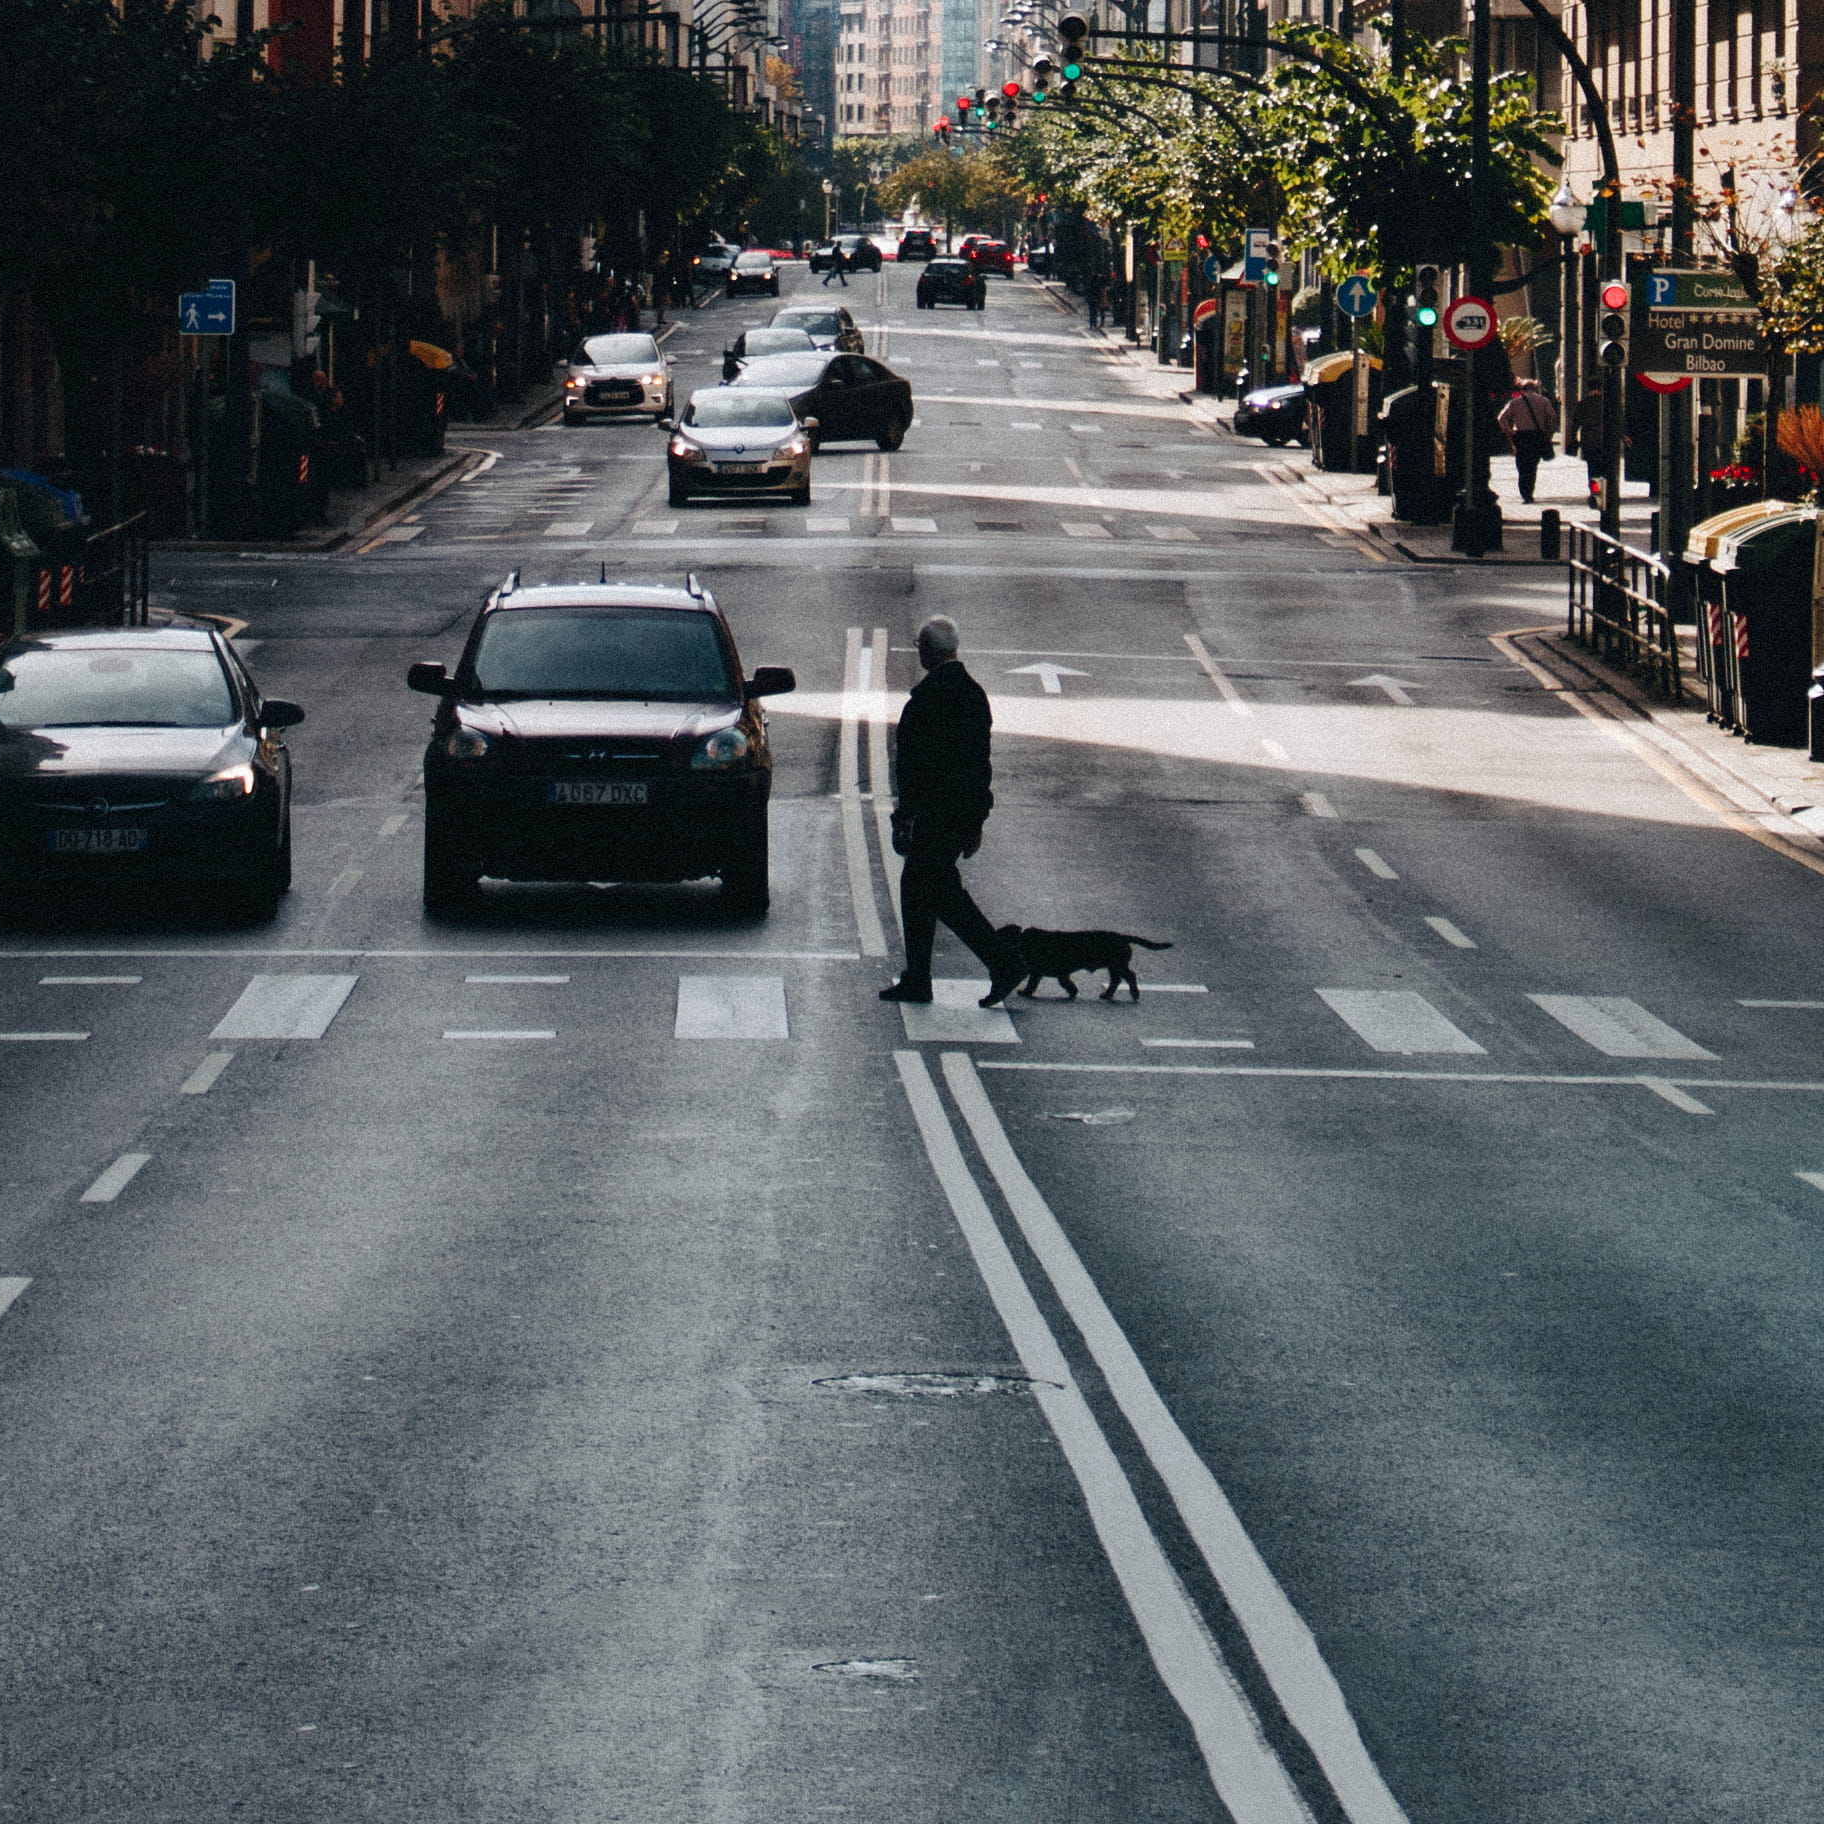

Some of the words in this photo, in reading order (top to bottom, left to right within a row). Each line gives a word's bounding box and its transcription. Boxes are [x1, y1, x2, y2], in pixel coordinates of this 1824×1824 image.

[1648, 313, 1685, 328] Hotel
[1664, 333, 1698, 350] Gran
[1702, 333, 1756, 351] Domine
[1685, 354, 1727, 372] Bilbao
